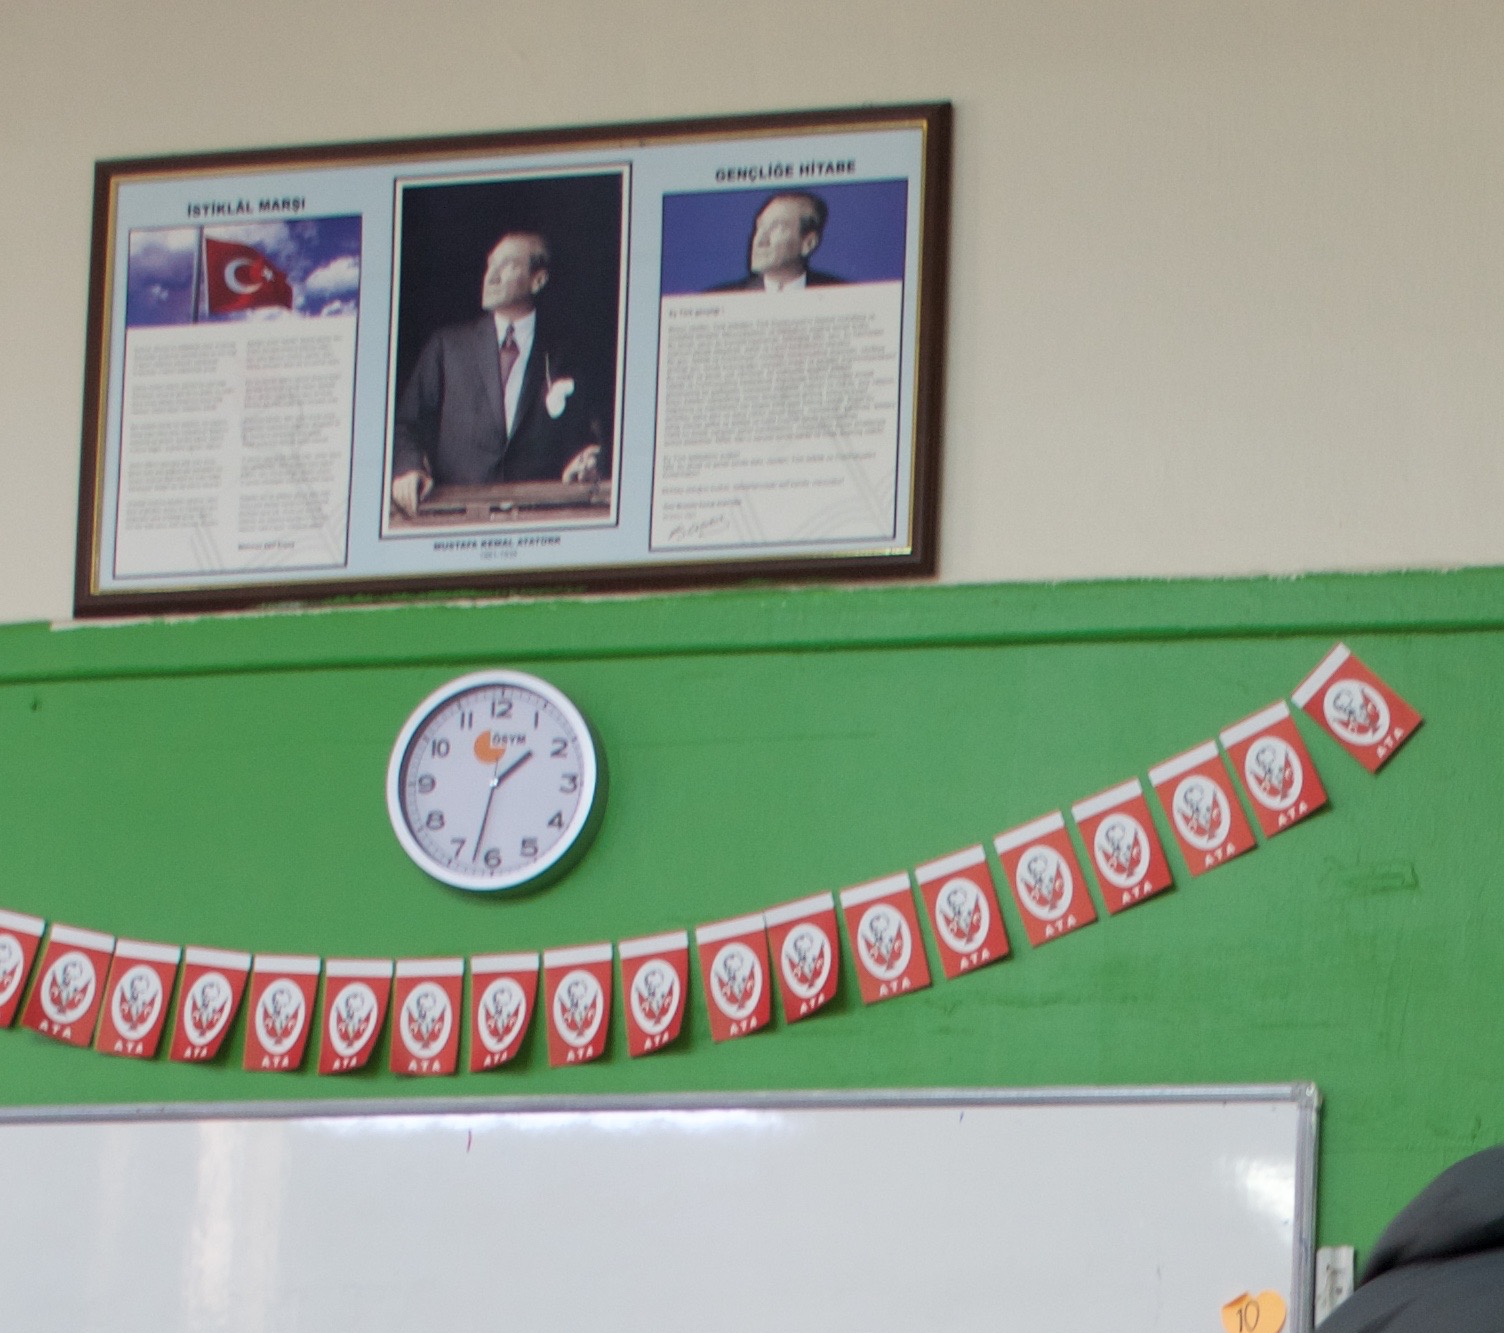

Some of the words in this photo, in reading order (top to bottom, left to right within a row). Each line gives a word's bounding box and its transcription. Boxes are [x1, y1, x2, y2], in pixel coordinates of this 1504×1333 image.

[715, 161, 794, 183] GENÇLİĞE
[799, 158, 856, 177] HİTABE
[258, 196, 306, 213] MARŞI
[491, 700, 513, 718] 12
[460, 712, 473, 729] 11
[431, 739, 450, 759] 10
[550, 739, 569, 759] 2
[1376, 727, 1404, 759] ATA
[418, 774, 436, 793] 9
[560, 774, 578, 794] 3
[426, 811, 445, 830] 8
[547, 812, 564, 829] 4
[1278, 801, 1308, 827] ATA
[451, 838, 466, 858] 7
[520, 838, 538, 857] 5
[1205, 843, 1235, 868] ATA
[484, 847, 502, 868] 6
[1122, 881, 1153, 905] ATA
[1045, 915, 1077, 937] ATA
[960, 949, 991, 970] ATA
[879, 977, 911, 997] ATA
[800, 993, 825, 1015] ATA
[38, 1021, 72, 1039] ATA
[730, 1017, 758, 1036] ATA
[113, 1040, 144, 1055] ATA
[644, 1033, 669, 1050] ATA
[183, 1046, 208, 1058] ATA
[261, 1055, 290, 1068] ATA
[483, 1052, 507, 1066] ATA
[566, 1047, 593, 1061] ATA
[332, 1057, 357, 1071] ATA
[408, 1060, 441, 1073] ATA
[1236, 1299, 1261, 1333] 10
